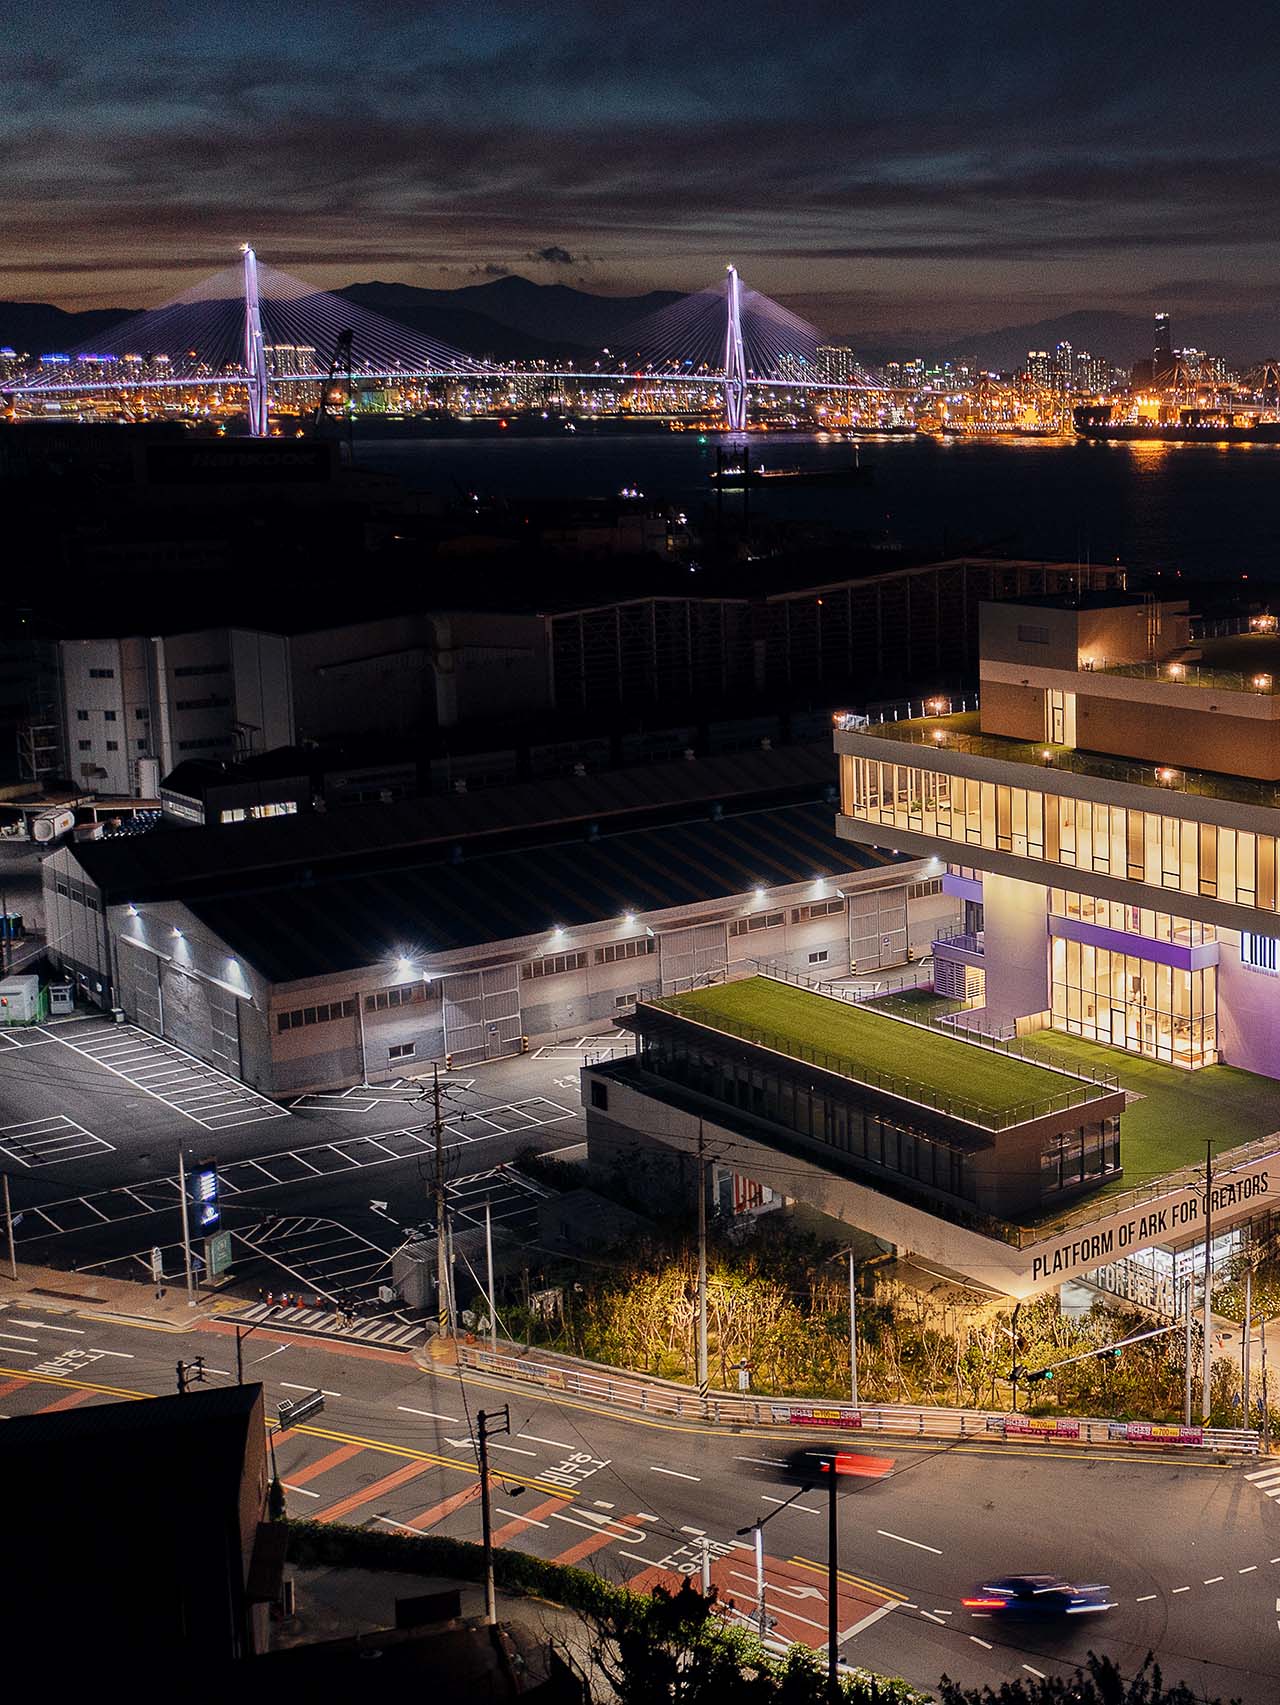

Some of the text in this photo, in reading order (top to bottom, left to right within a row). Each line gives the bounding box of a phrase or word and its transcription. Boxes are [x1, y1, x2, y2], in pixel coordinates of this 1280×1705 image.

[1032, 1230, 1114, 1281] PLATFORM
[1118, 1221, 1137, 1248] OF
[1138, 1209, 1168, 1240] ARK
[1172, 1201, 1197, 1227] FOR
[27, 1349, 105, 1377] 비보호
[534, 1452, 612, 1488] 비보호
